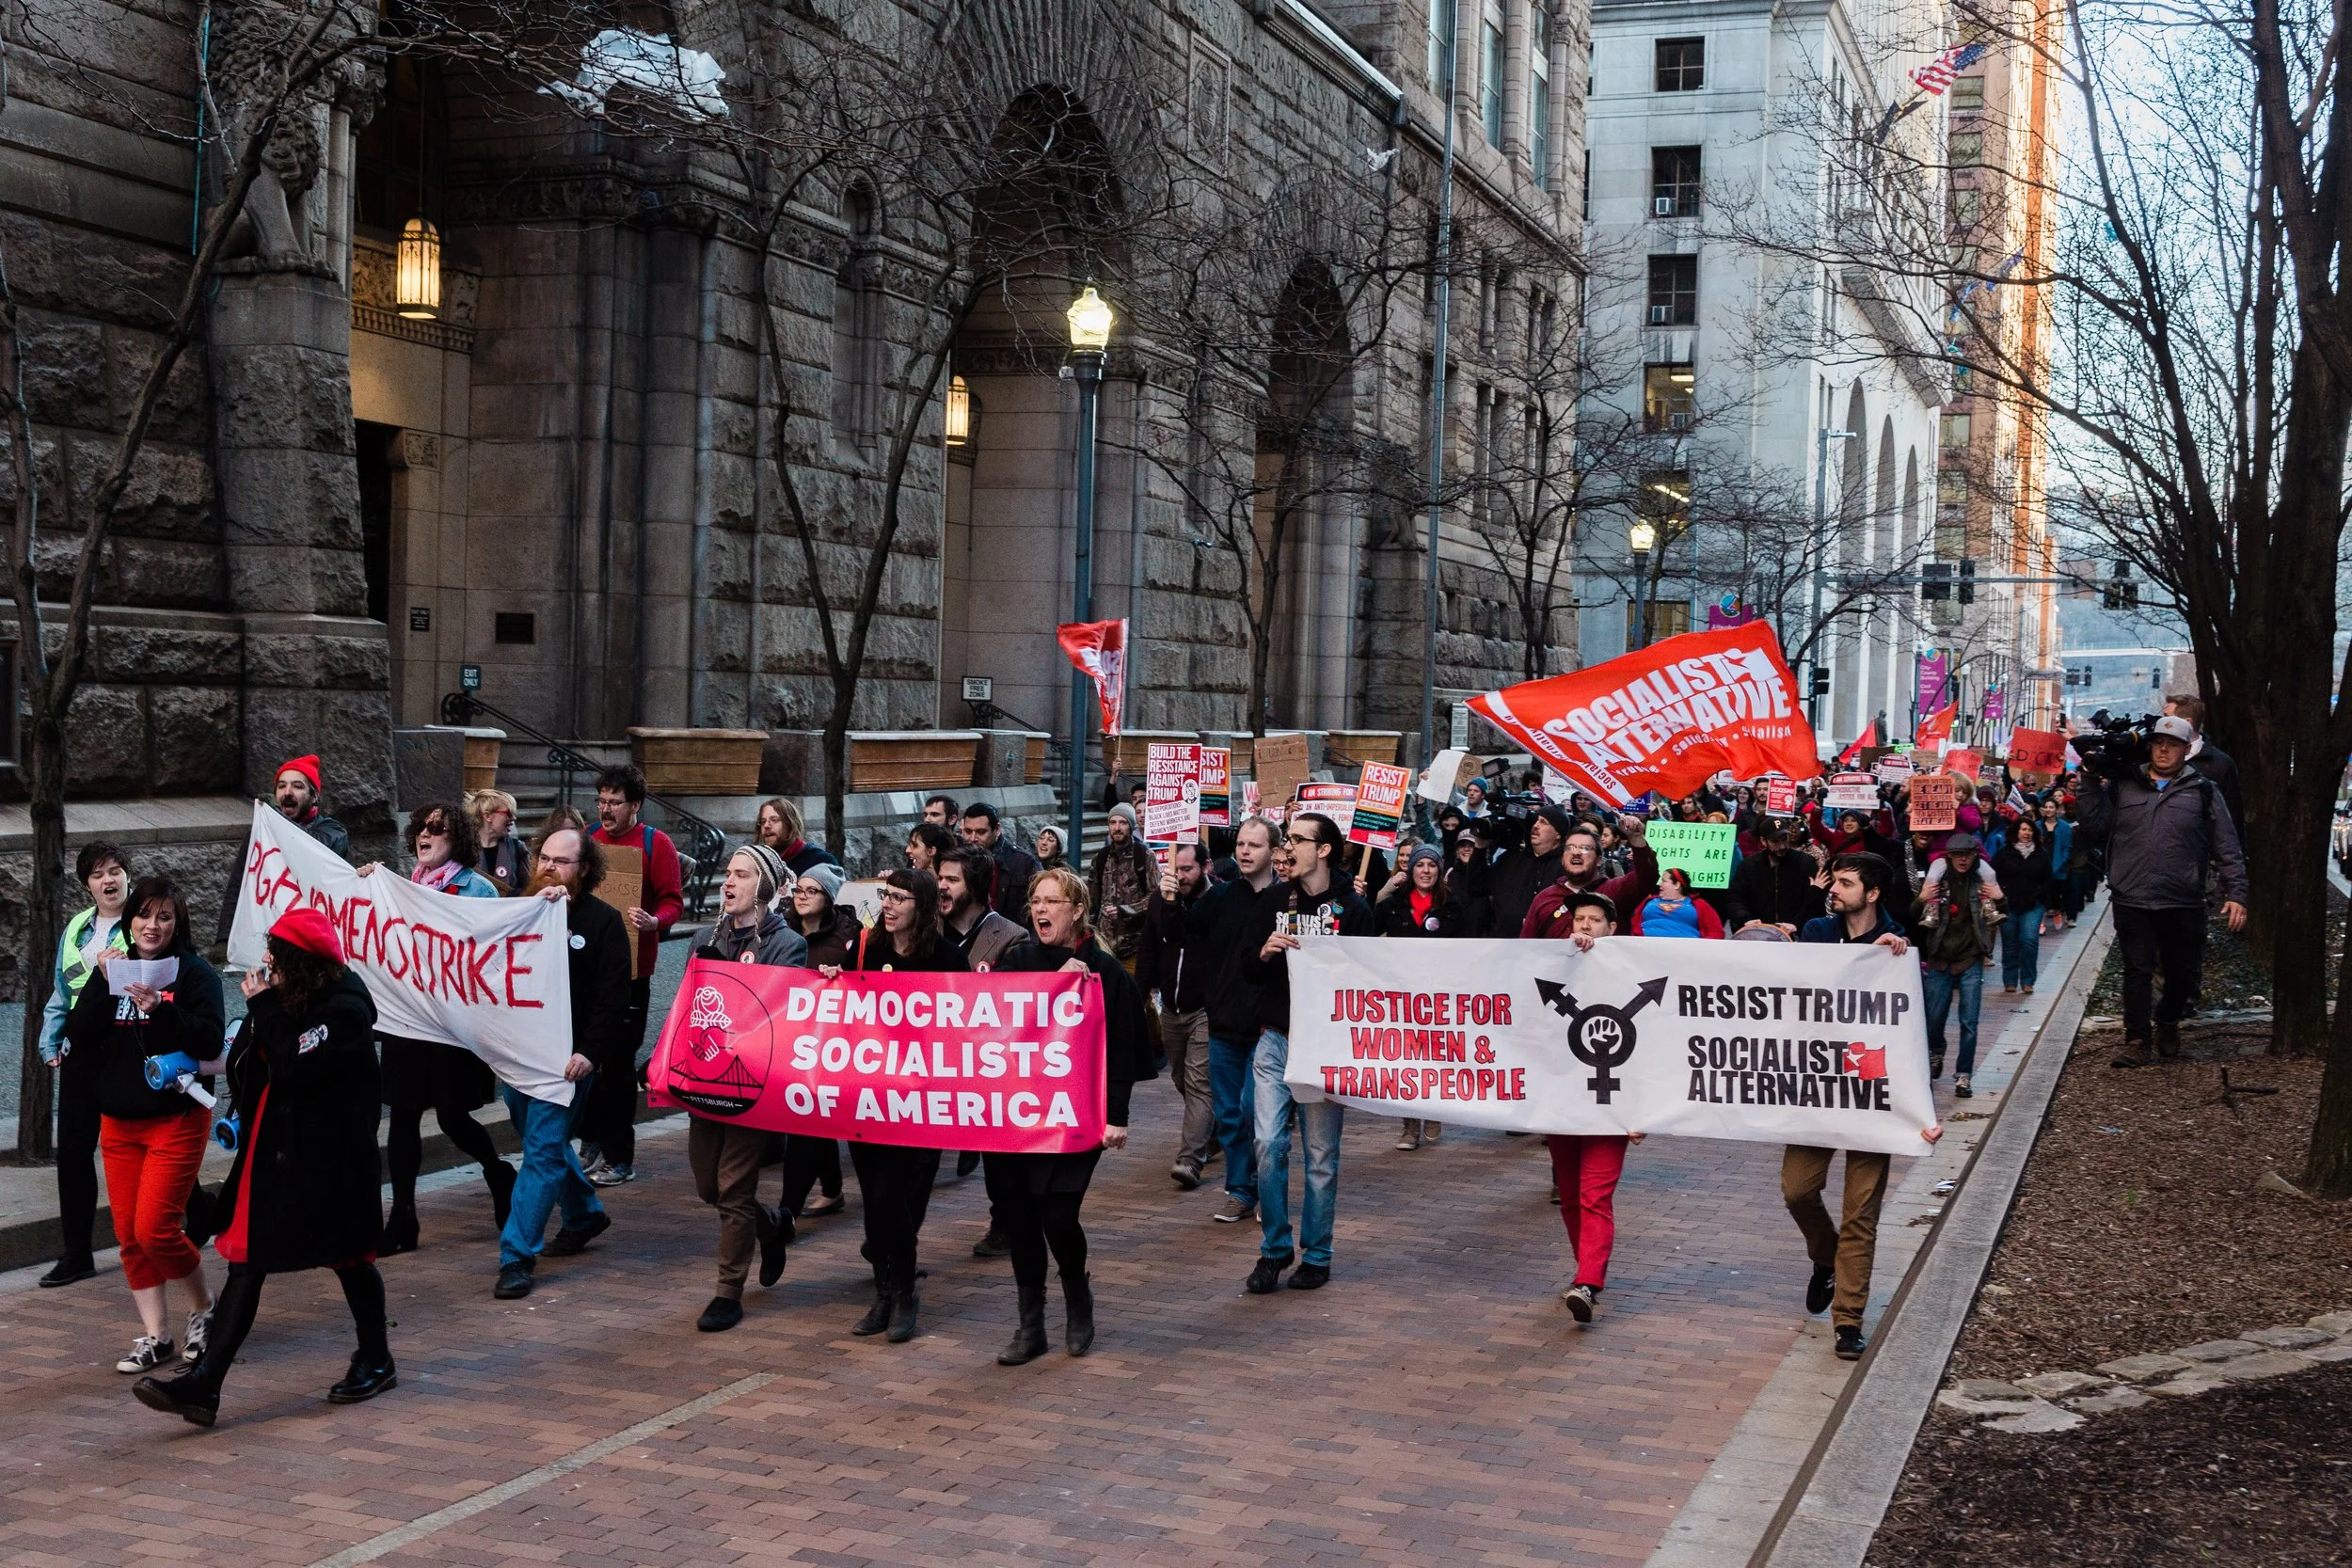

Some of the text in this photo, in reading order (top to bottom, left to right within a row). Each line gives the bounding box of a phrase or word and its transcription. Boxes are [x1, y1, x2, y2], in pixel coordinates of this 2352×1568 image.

[464, 669, 478, 677] EXIT
[463, 678, 479, 687] ONLY
[1542, 650, 1733, 744] SOCIALIST
[1577, 676, 1792, 769] ATERNATIVE
[1151, 746, 1192, 759] BUILD THE
[1201, 752, 1226, 768] SIST
[1150, 760, 1199, 773] RESISTANCE
[1149, 773, 1185, 787] AGAINST
[1200, 768, 1226, 784] UMP
[1365, 765, 1406, 786] RESIST
[1148, 787, 1179, 800] TRUMP
[1308, 789, 1315, 798] AM
[1343, 787, 1354, 796] FOR
[1361, 783, 1402, 805] TRUMP
[1149, 813, 1163, 821] BLACK
[1163, 810, 1173, 818] LIVES
[1150, 819, 1166, 828] DEFEND
[1773, 819, 1782, 829] P
[1656, 847, 1727, 860] IGHTS ARE
[1686, 871, 1725, 882] IGHTS
[411, 922, 544, 1008] STRIKE
[787, 987, 1085, 1028] DEMOCRATIC
[1330, 989, 1513, 1026] JUSTICE FOR
[1677, 984, 1910, 1026] RESIST TRUMP
[1350, 1026, 1496, 1065] WOMEN &
[789, 1036, 1073, 1078] SOCIALISTS
[1688, 1035, 1848, 1075] SOCIALIST
[1320, 1065, 1527, 1101] TRANSPEOPLE
[1687, 1069, 1892, 1112] ALTERNATIVE
[690, 1095, 735, 1108] PITTSBURGH
[785, 1083, 1079, 1128] OF AMERICA
